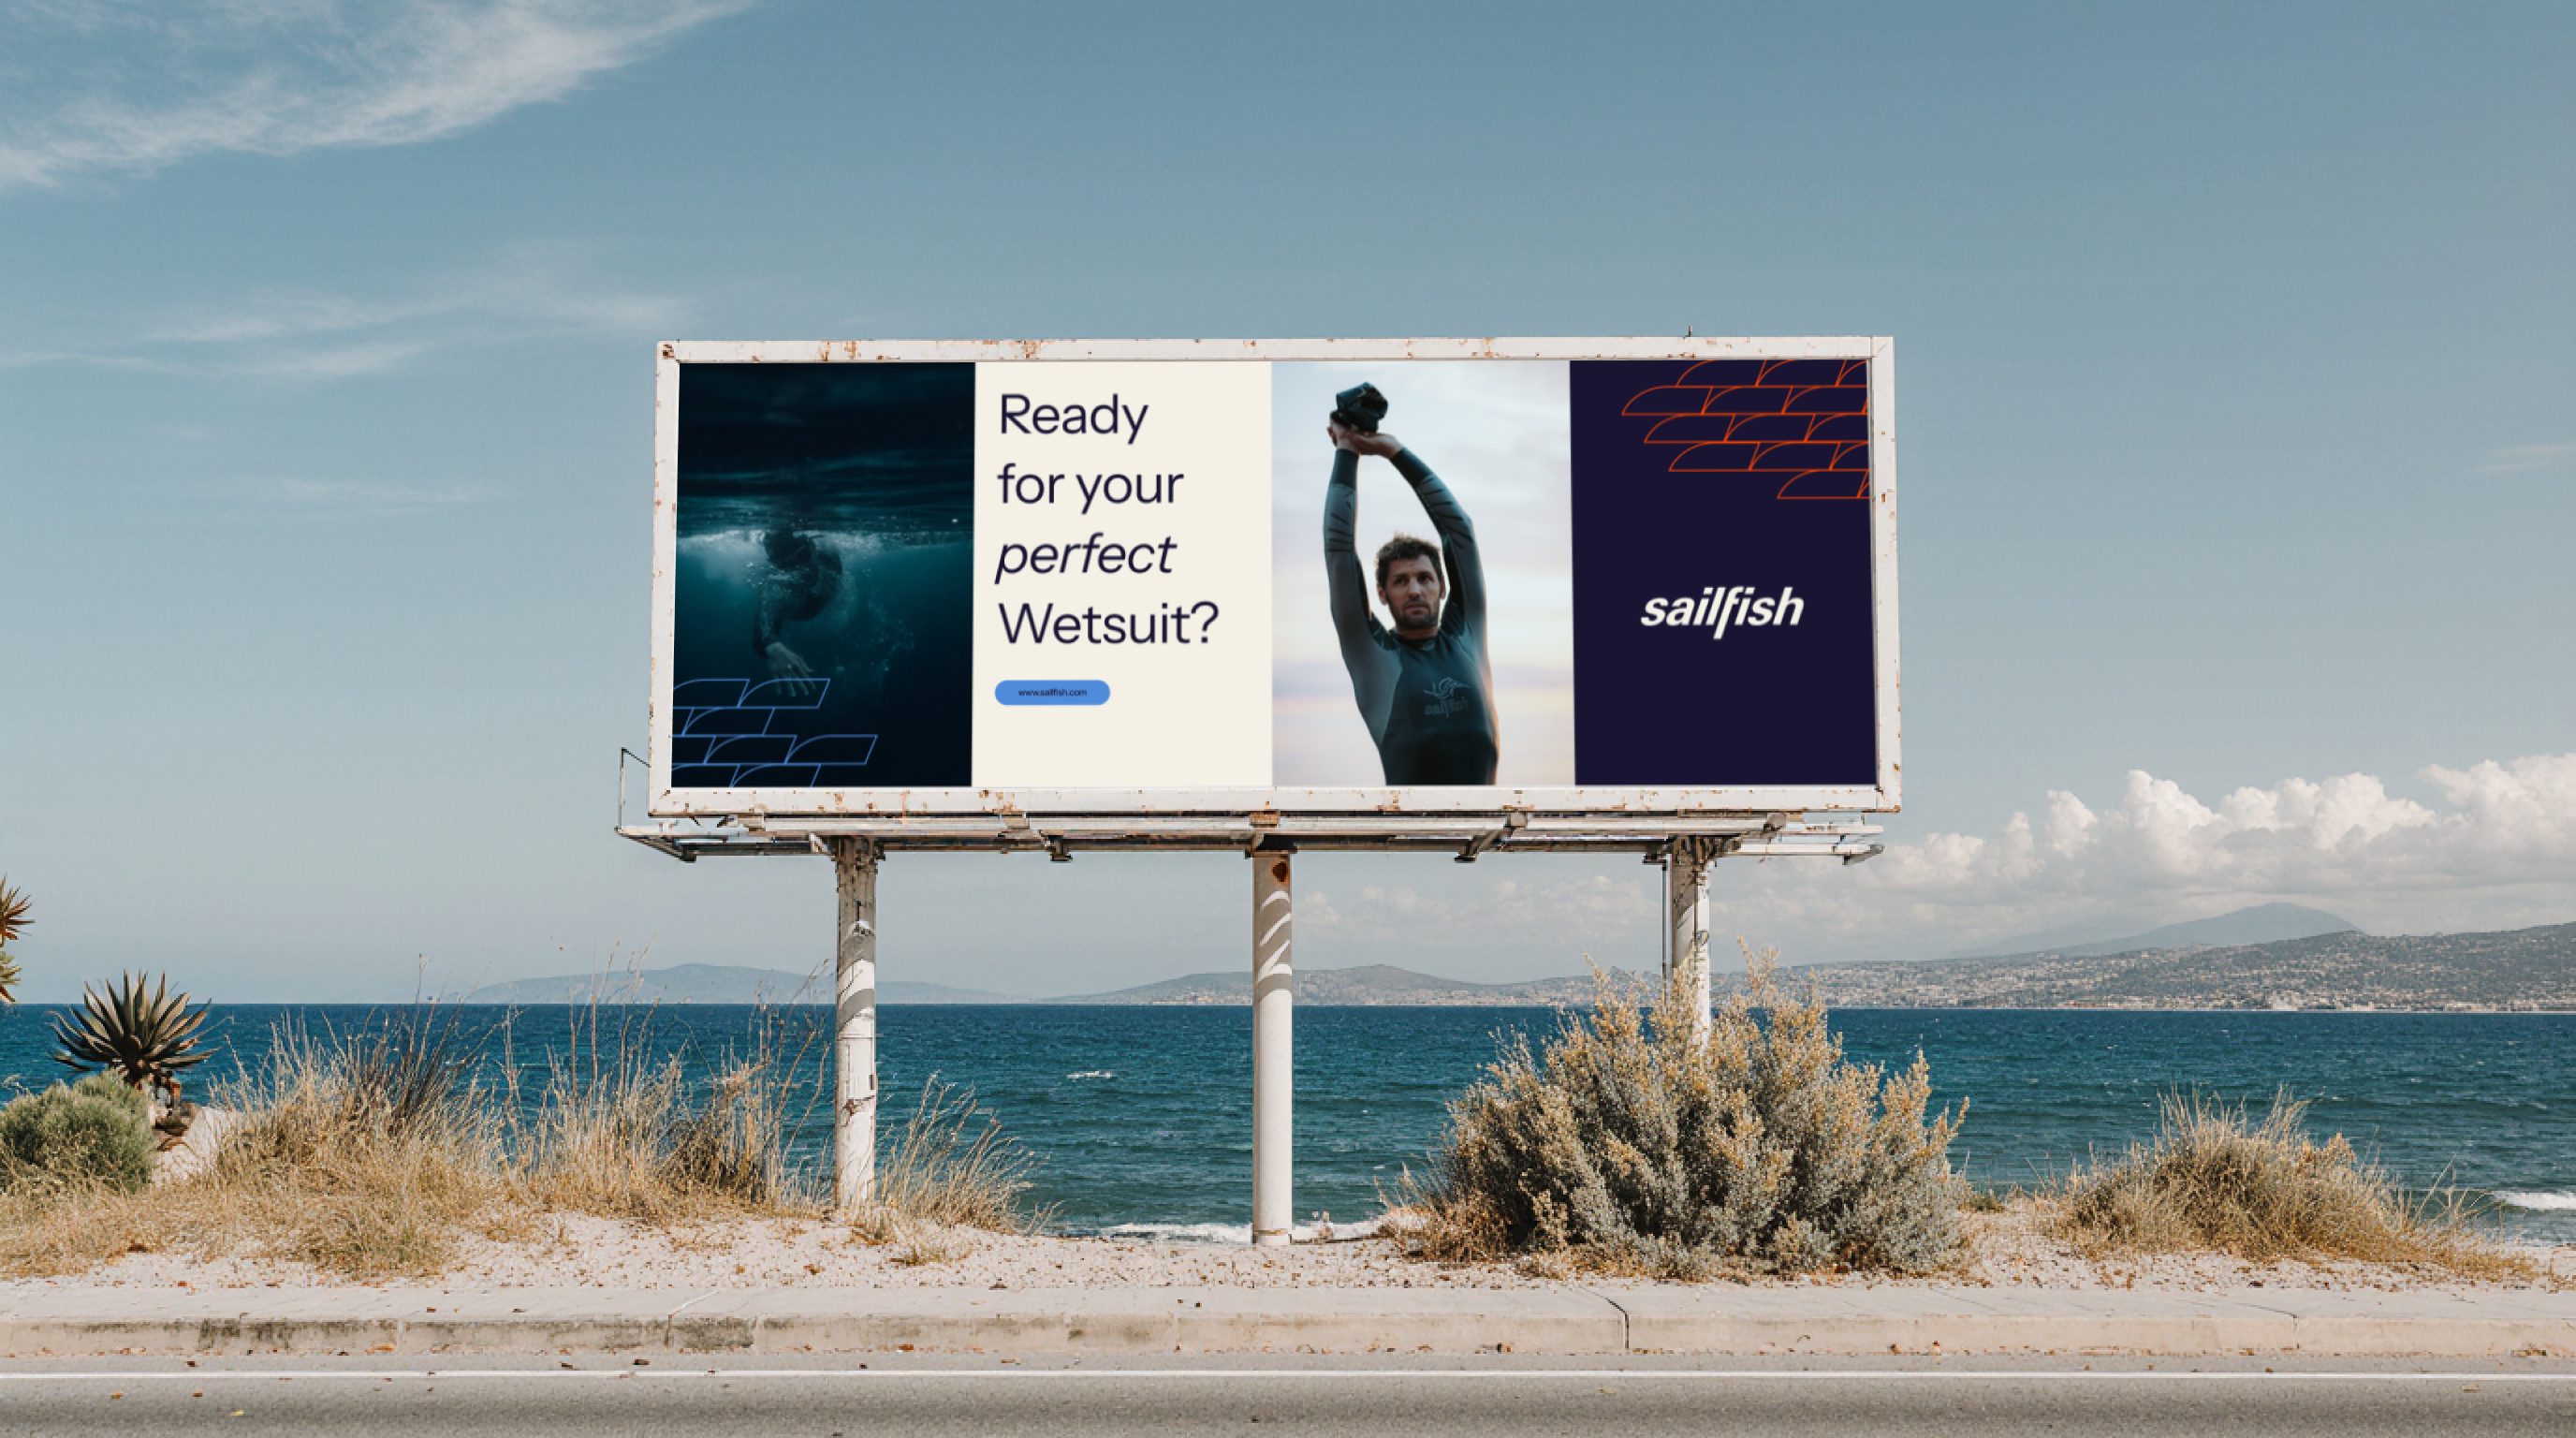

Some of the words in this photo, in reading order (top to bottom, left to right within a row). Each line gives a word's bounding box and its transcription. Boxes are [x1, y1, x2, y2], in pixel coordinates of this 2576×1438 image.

[1001, 393, 1149, 445] Ready
[997, 462, 1065, 504] for
[1076, 474, 1184, 515] your
[994, 532, 1178, 585] perfect
[998, 601, 1219, 644] Wetsuit?
[1640, 586, 1805, 640] sailfish
[1017, 688, 1088, 697] www.sailfish.com
